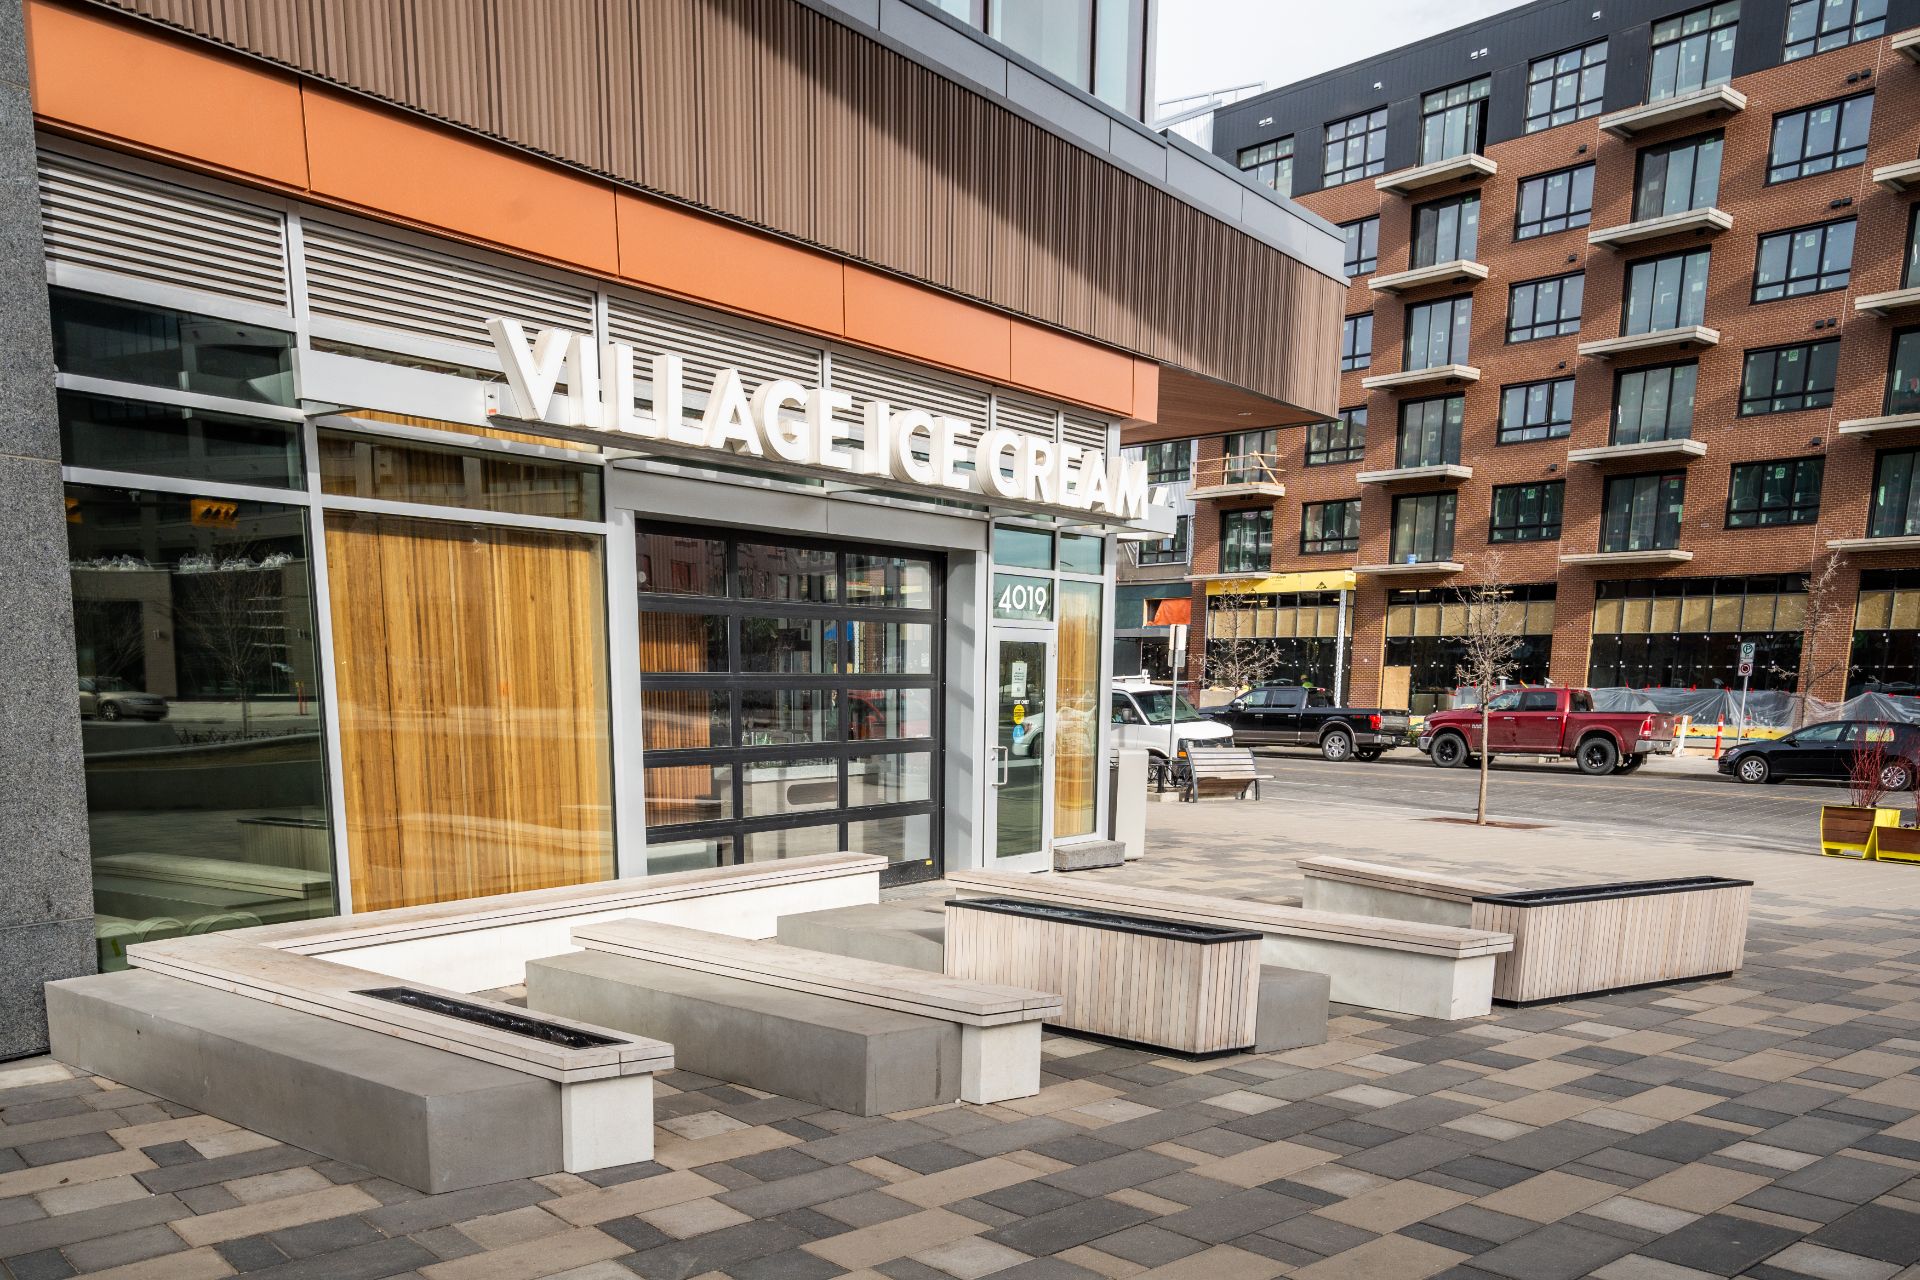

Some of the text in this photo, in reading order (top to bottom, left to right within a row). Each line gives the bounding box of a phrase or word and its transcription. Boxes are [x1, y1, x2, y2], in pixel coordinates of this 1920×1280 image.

[486, 316, 1149, 521] VILLAGE ICE CREAM
[998, 583, 1047, 615] 4019
